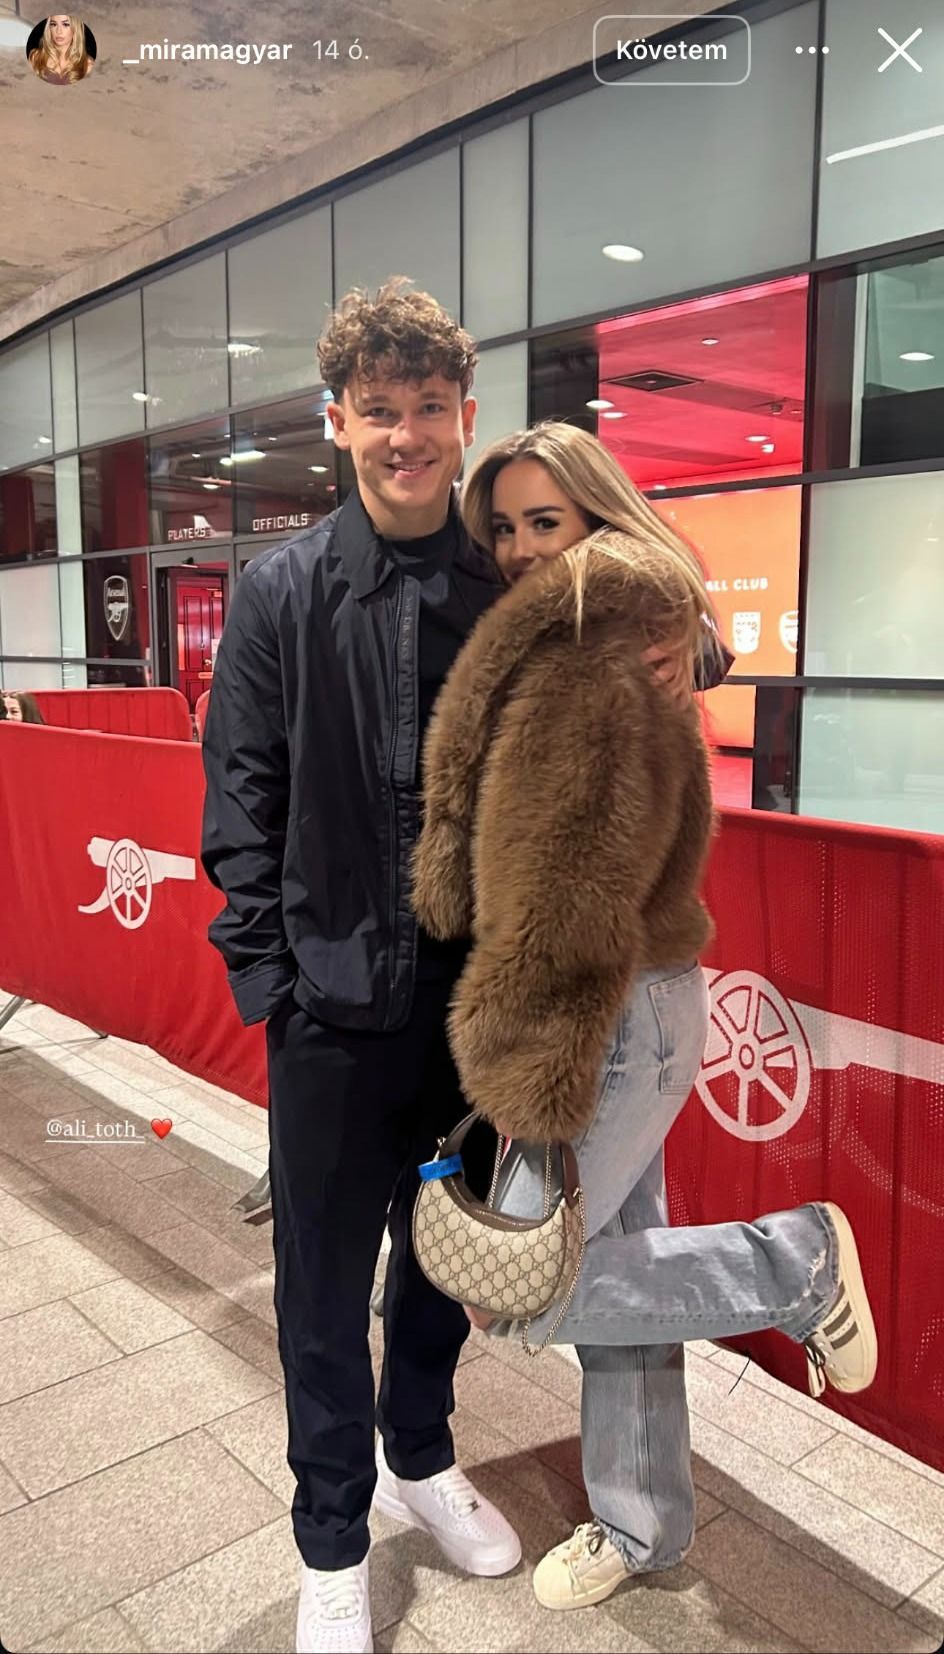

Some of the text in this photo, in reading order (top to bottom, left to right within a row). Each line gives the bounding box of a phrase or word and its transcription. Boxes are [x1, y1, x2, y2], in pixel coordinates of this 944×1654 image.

[253, 513, 309, 531] OFFICIALS
[167, 527, 206, 541] PLAYERS
[705, 577, 768, 592] ALL CLUB
